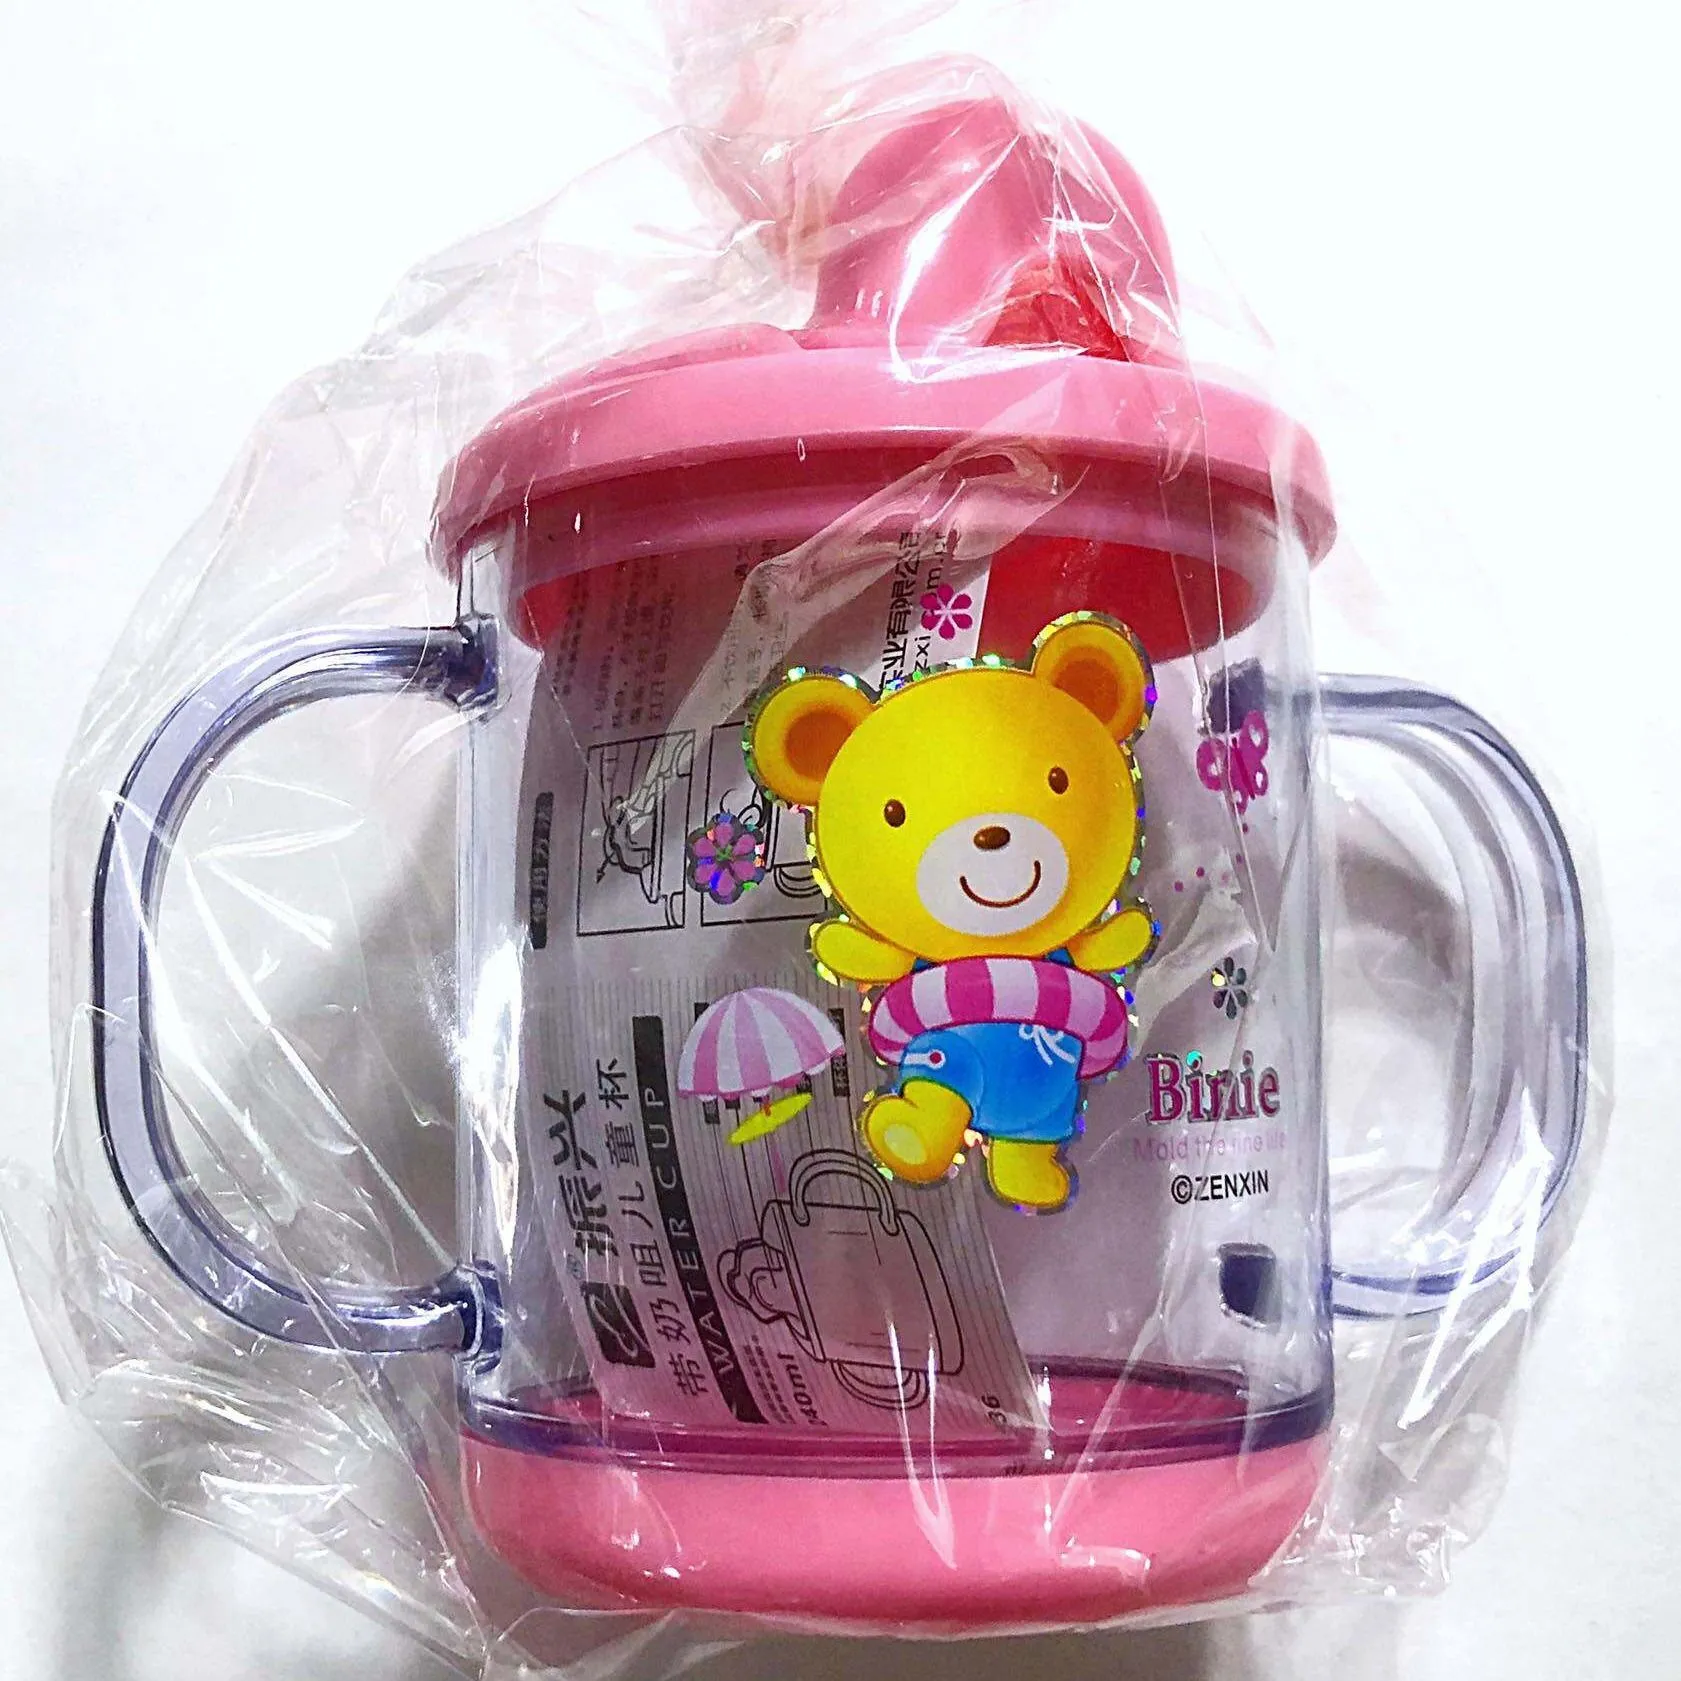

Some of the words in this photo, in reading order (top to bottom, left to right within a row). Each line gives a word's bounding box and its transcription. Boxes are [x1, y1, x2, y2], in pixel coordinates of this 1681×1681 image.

[543, 1089, 619, 1257] 振兴
[644, 1087, 678, 1190] CUP
[596, 1057, 709, 1397] 带奶咀儿童杯
[668, 1216, 735, 1375] WATER
